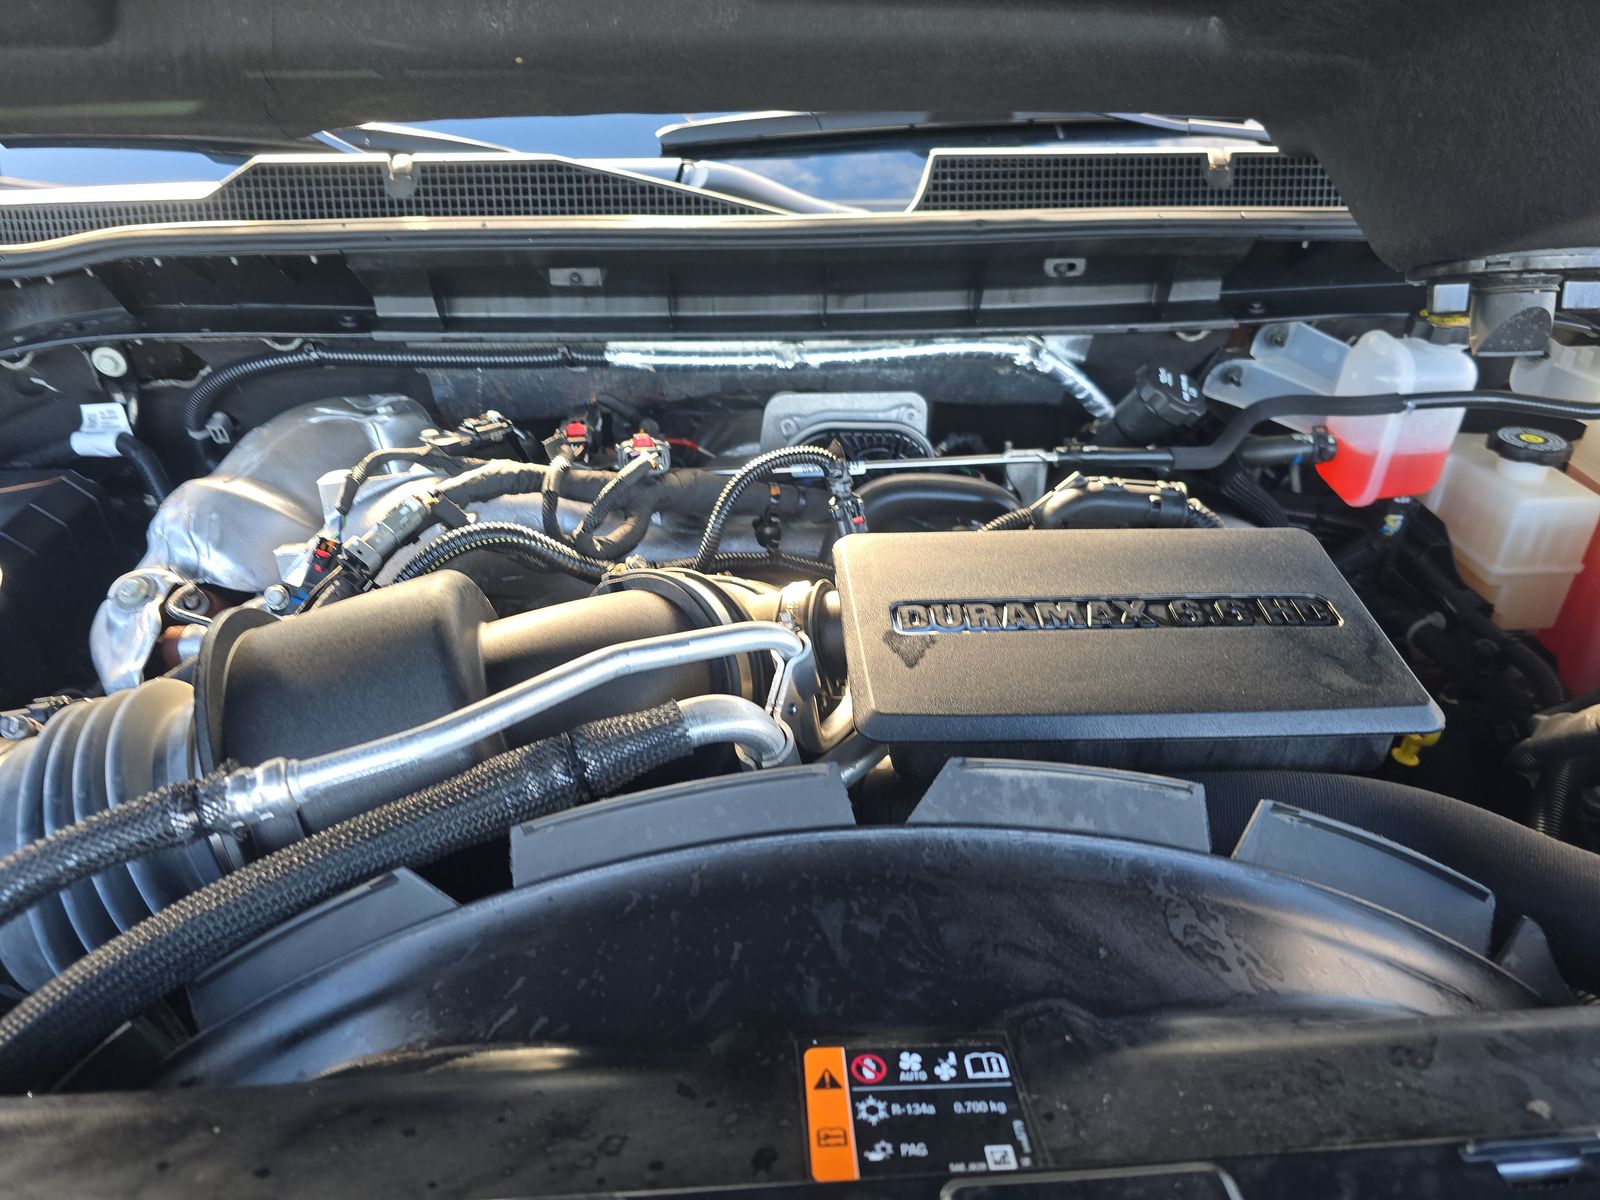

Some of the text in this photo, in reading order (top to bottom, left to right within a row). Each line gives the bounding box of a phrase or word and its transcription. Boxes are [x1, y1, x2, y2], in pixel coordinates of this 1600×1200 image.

[895, 598, 1341, 630] DURAMAX 6.6 HD
[899, 1070, 928, 1081] AUTO
[891, 1102, 936, 1115] R-134a
[989, 1100, 1007, 1115] kg
[900, 1143, 928, 1157] PAG
